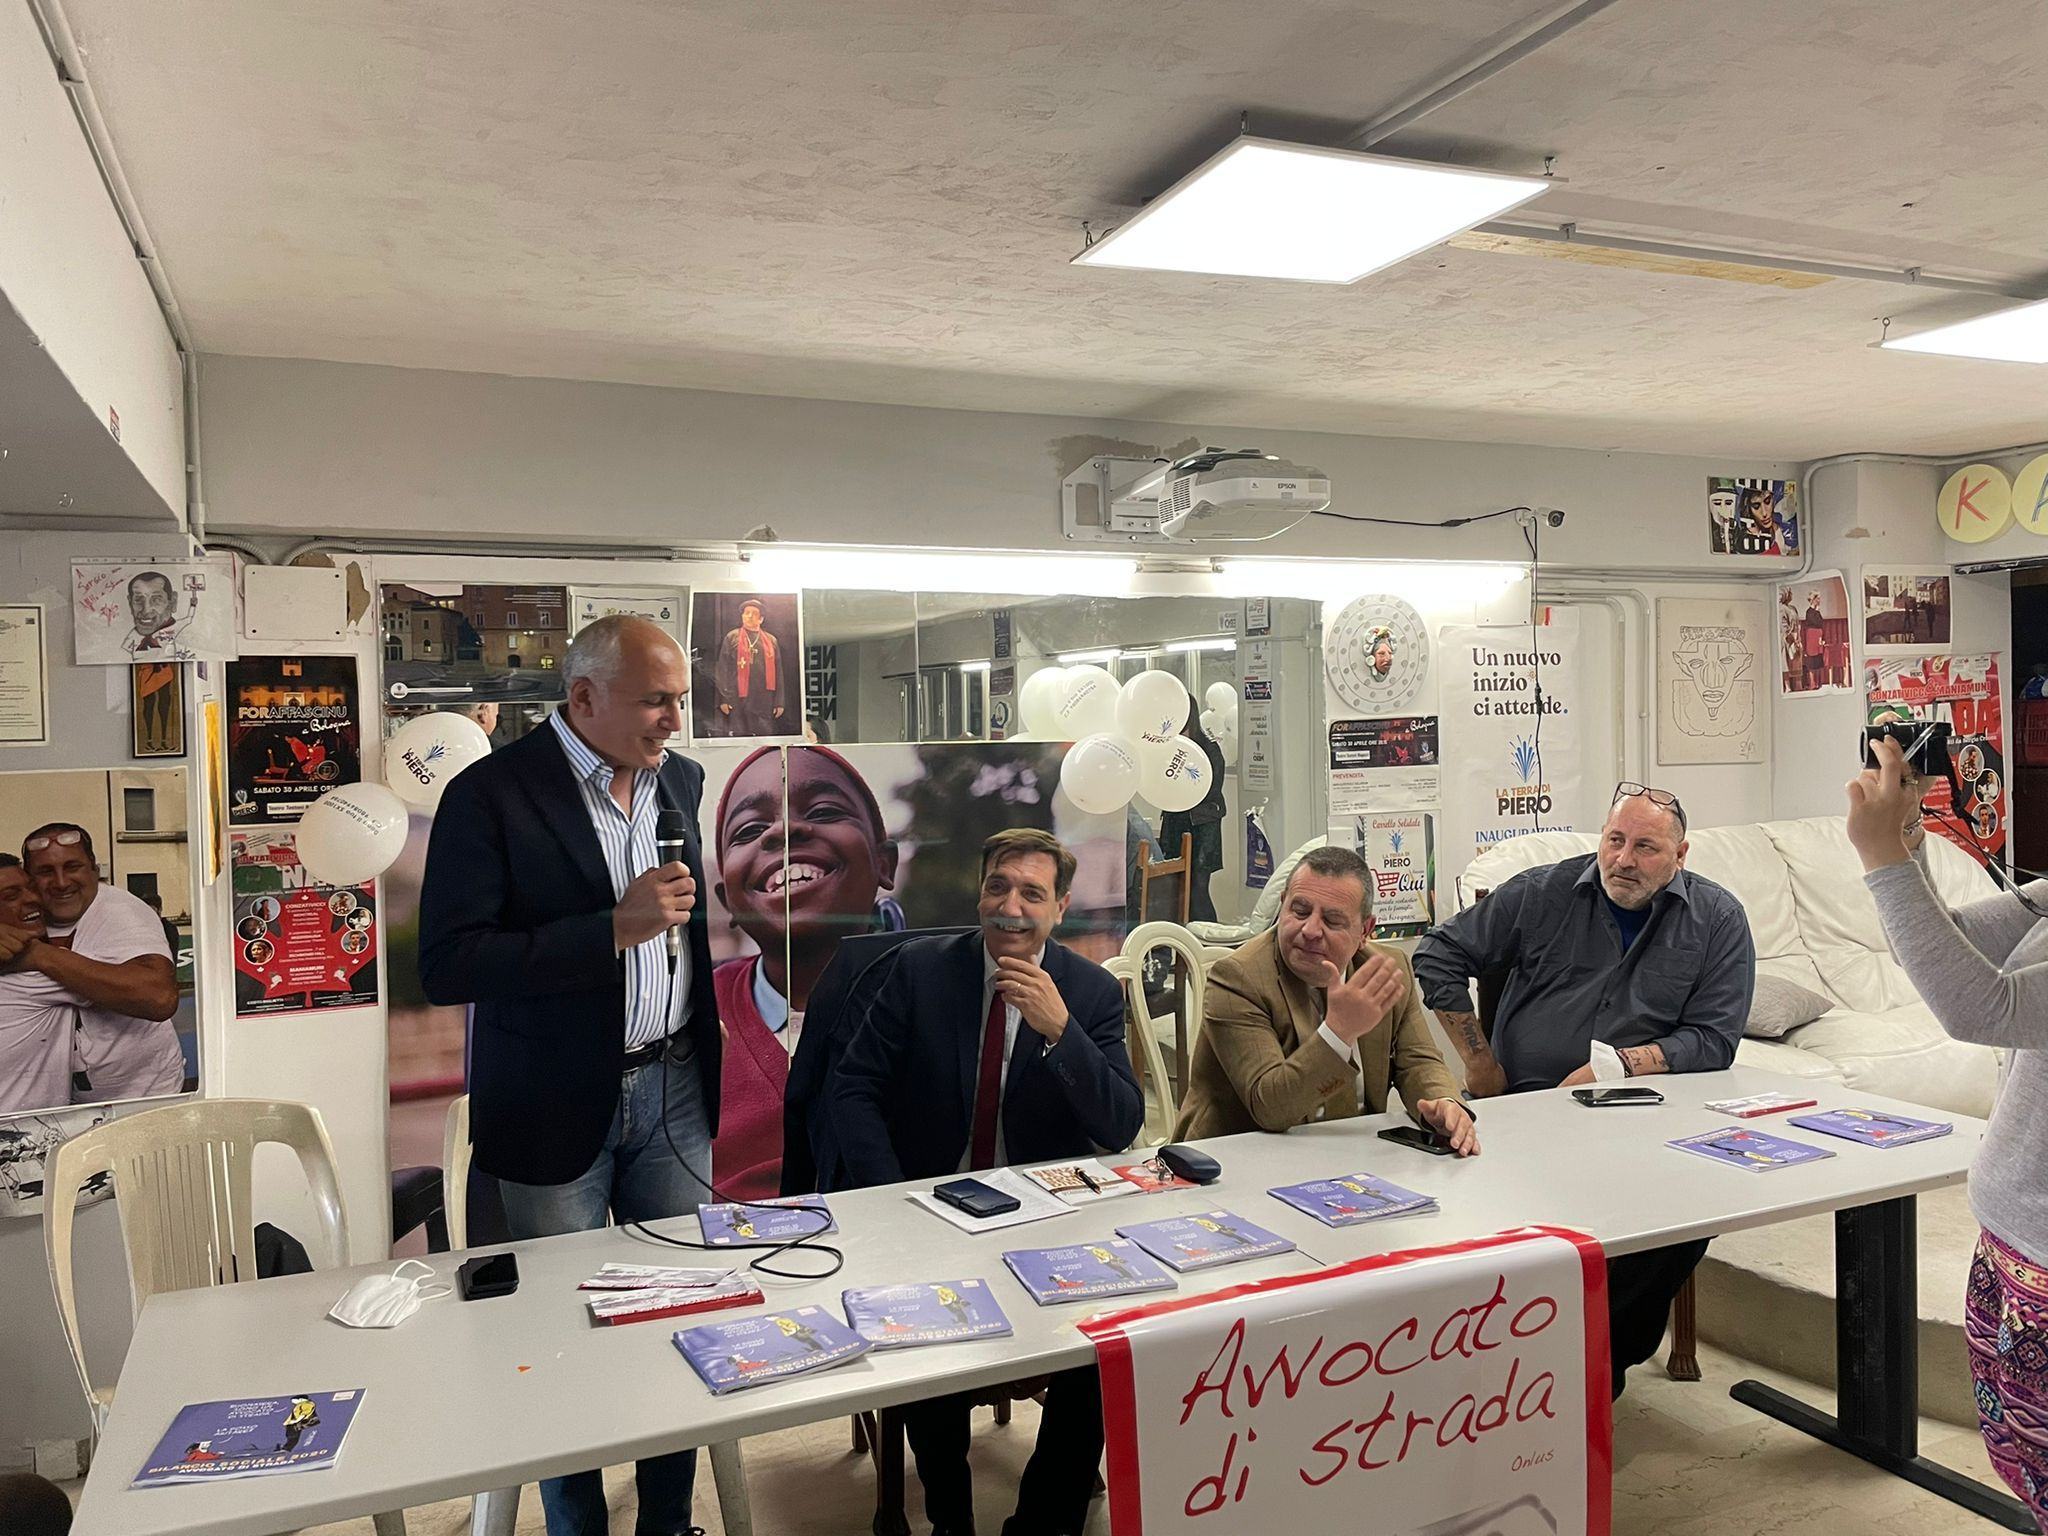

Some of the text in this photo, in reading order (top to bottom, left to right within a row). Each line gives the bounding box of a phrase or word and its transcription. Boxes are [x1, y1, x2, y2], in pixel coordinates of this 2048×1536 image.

[1472, 648, 1561, 666] Un nuovo
[1473, 672, 1528, 691] inizio
[238, 706, 347, 719] FORAFFASCINU
[1473, 696, 1568, 716] ci attende.
[310, 718, 352, 734] Bologna
[402, 752, 431, 786] PIERO
[1165, 748, 1181, 778] PIERO
[254, 786, 282, 794] SABATO
[283, 786, 292, 794] 30
[1496, 784, 1550, 798] LA TERRA DI
[1498, 795, 1552, 816] PIERO
[1384, 858, 1410, 868] PIERO
[1399, 875, 1424, 891] Qui
[1180, 1274, 1558, 1425] Avvocato
[1185, 1358, 1556, 1517] di strada
[148, 1449, 328, 1474] BILANCIO SOCIALE 2020
[178, 1466, 234, 1474] AVVOCATO
[252, 1460, 295, 1468] STRADA
[1512, 1447, 1555, 1472] Onlus
